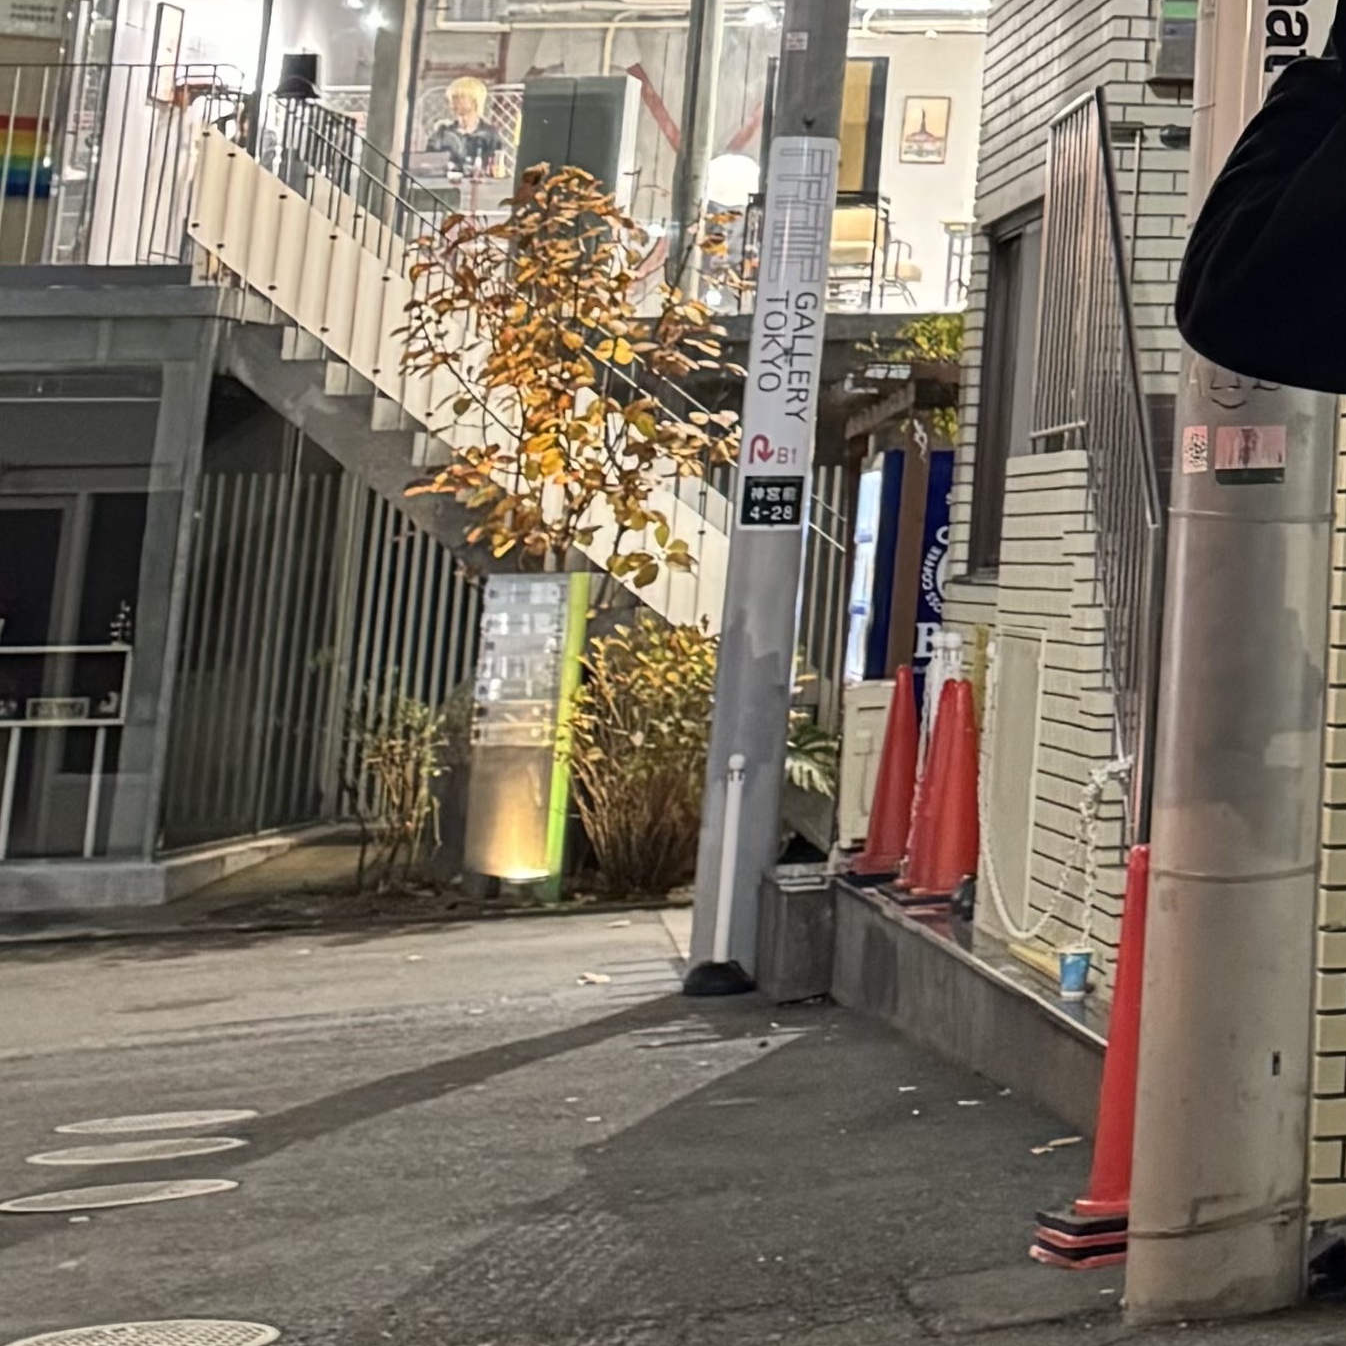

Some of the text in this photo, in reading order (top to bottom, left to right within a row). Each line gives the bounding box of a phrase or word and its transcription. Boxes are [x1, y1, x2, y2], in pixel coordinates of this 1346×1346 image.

[758, 290, 790, 393] TOKYO
[785, 291, 818, 423] GALLERY
[776, 446, 797, 464] B1
[749, 505, 793, 521] 4-28
